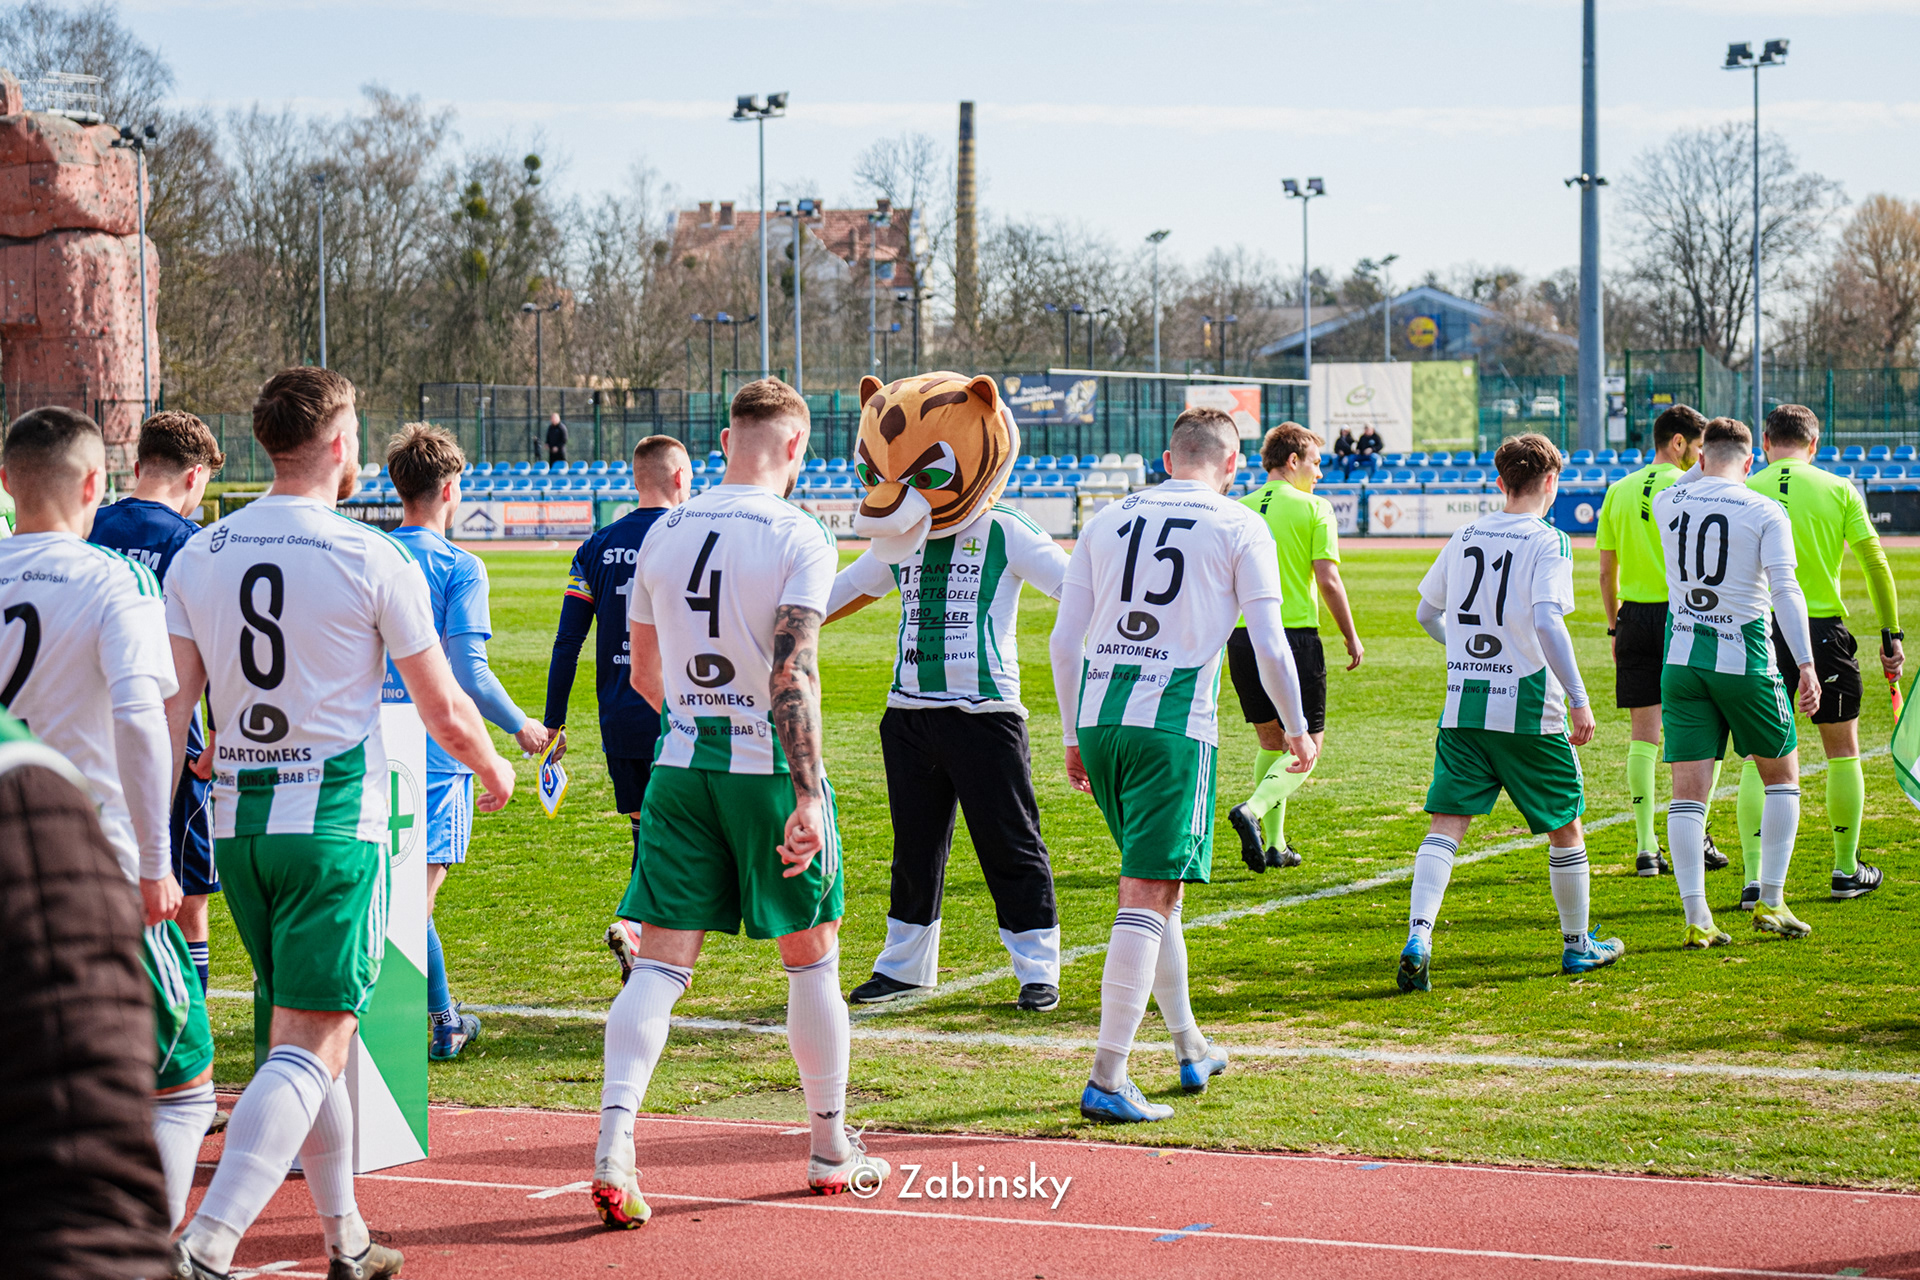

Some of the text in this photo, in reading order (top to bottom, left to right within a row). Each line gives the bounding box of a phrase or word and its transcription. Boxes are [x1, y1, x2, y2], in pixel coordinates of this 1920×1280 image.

[1139, 498, 1219, 513] Starogard Gdański
[1686, 494, 1719, 503] Starogard
[684, 510, 773, 526] Starogard Gdański
[1870, 512, 1892, 524] UR
[1473, 529, 1505, 538] Starogard
[230, 533, 334, 552] Starogard Gdański
[1668, 510, 1729, 587] 10
[116, 547, 162, 571] EM
[602, 547, 638, 565] STO
[1116, 515, 1198, 606] 15
[685, 531, 721, 639] 4
[913, 576, 941, 584] DRZWI
[957, 576, 980, 584] LATA
[1457, 546, 1514, 627] 21
[1678, 605, 1733, 624] DAOMEKS
[239, 562, 285, 691] 8
[612, 654, 631, 665] GNI
[1096, 643, 1169, 661] DARTOMEKS
[1447, 661, 1513, 674] DARTOMEKS
[383, 688, 405, 699] INO
[1447, 684, 1507, 695] NER KING KEBAB
[679, 693, 755, 708] ARTOMEKS
[670, 719, 754, 737] ÖNER ING KEBAB
[218, 746, 312, 763] DARTOMEKS
[239, 774, 265, 787] KING
[268, 772, 305, 785] KEBAB
